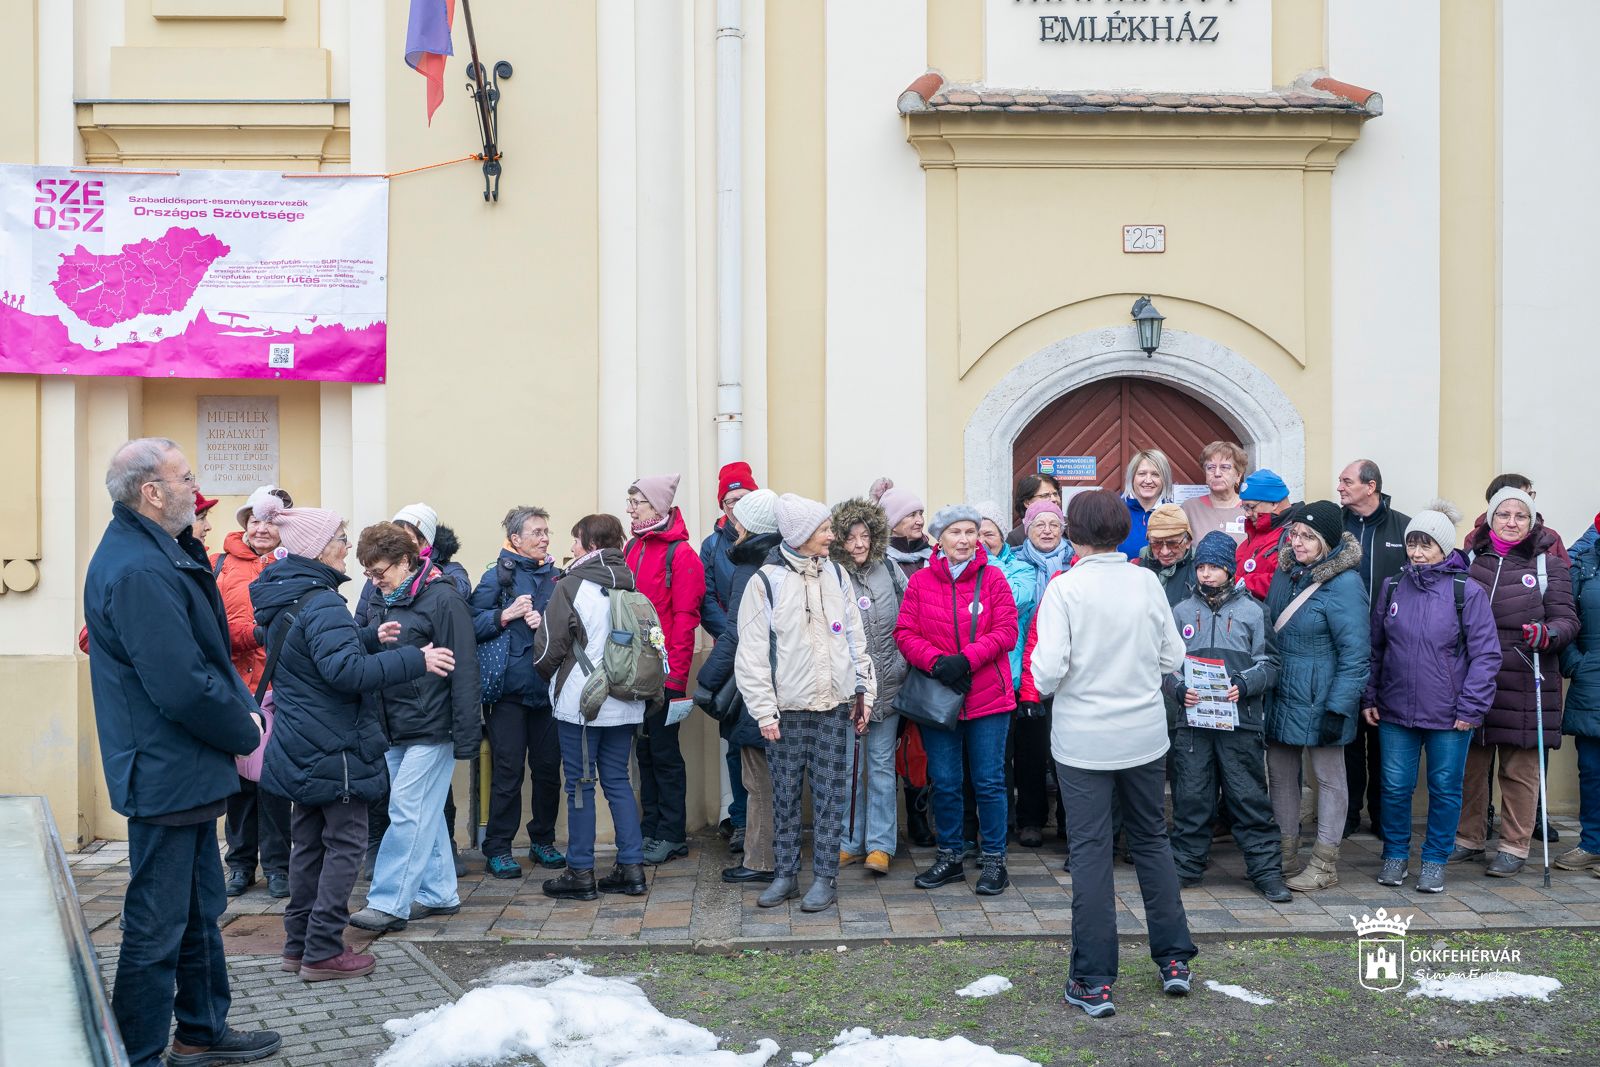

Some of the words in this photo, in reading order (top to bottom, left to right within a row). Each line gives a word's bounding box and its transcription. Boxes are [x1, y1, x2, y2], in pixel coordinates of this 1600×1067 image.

[1039, 10, 1219, 42] EMLÉKHÁZ
[35, 178, 104, 205] SZE
[128, 195, 308, 207] Szabadidősport-eseményszervezők
[34, 206, 104, 232] OSZ
[134, 206, 207, 219] Országos
[213, 208, 305, 222] Szövetsége
[1132, 227, 1156, 249] 25
[286, 275, 320, 284] futás
[204, 463, 225, 471] COPF
[214, 473, 233, 481] 1790
